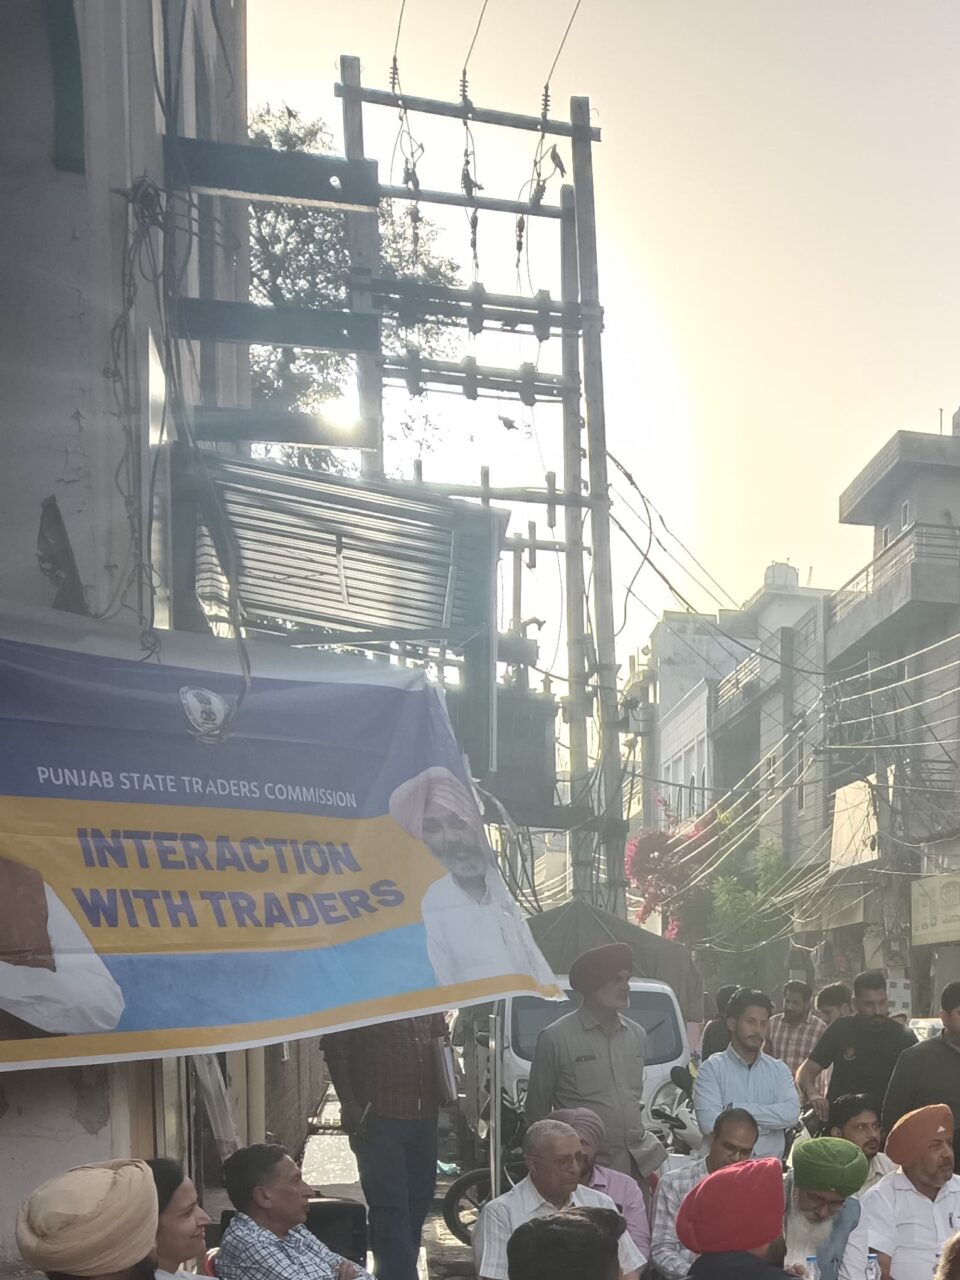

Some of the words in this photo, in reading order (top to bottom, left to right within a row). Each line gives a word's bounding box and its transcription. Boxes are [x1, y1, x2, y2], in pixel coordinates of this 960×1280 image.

[37, 766, 114, 788] PUNJAB
[119, 772, 176, 792] STATE
[181, 776, 260, 797] TRADERS
[264, 783, 357, 808] COMMISSION
[77, 827, 362, 875] INTERACTION
[71, 888, 198, 928] WITH
[199, 879, 405, 928] TRADERS
